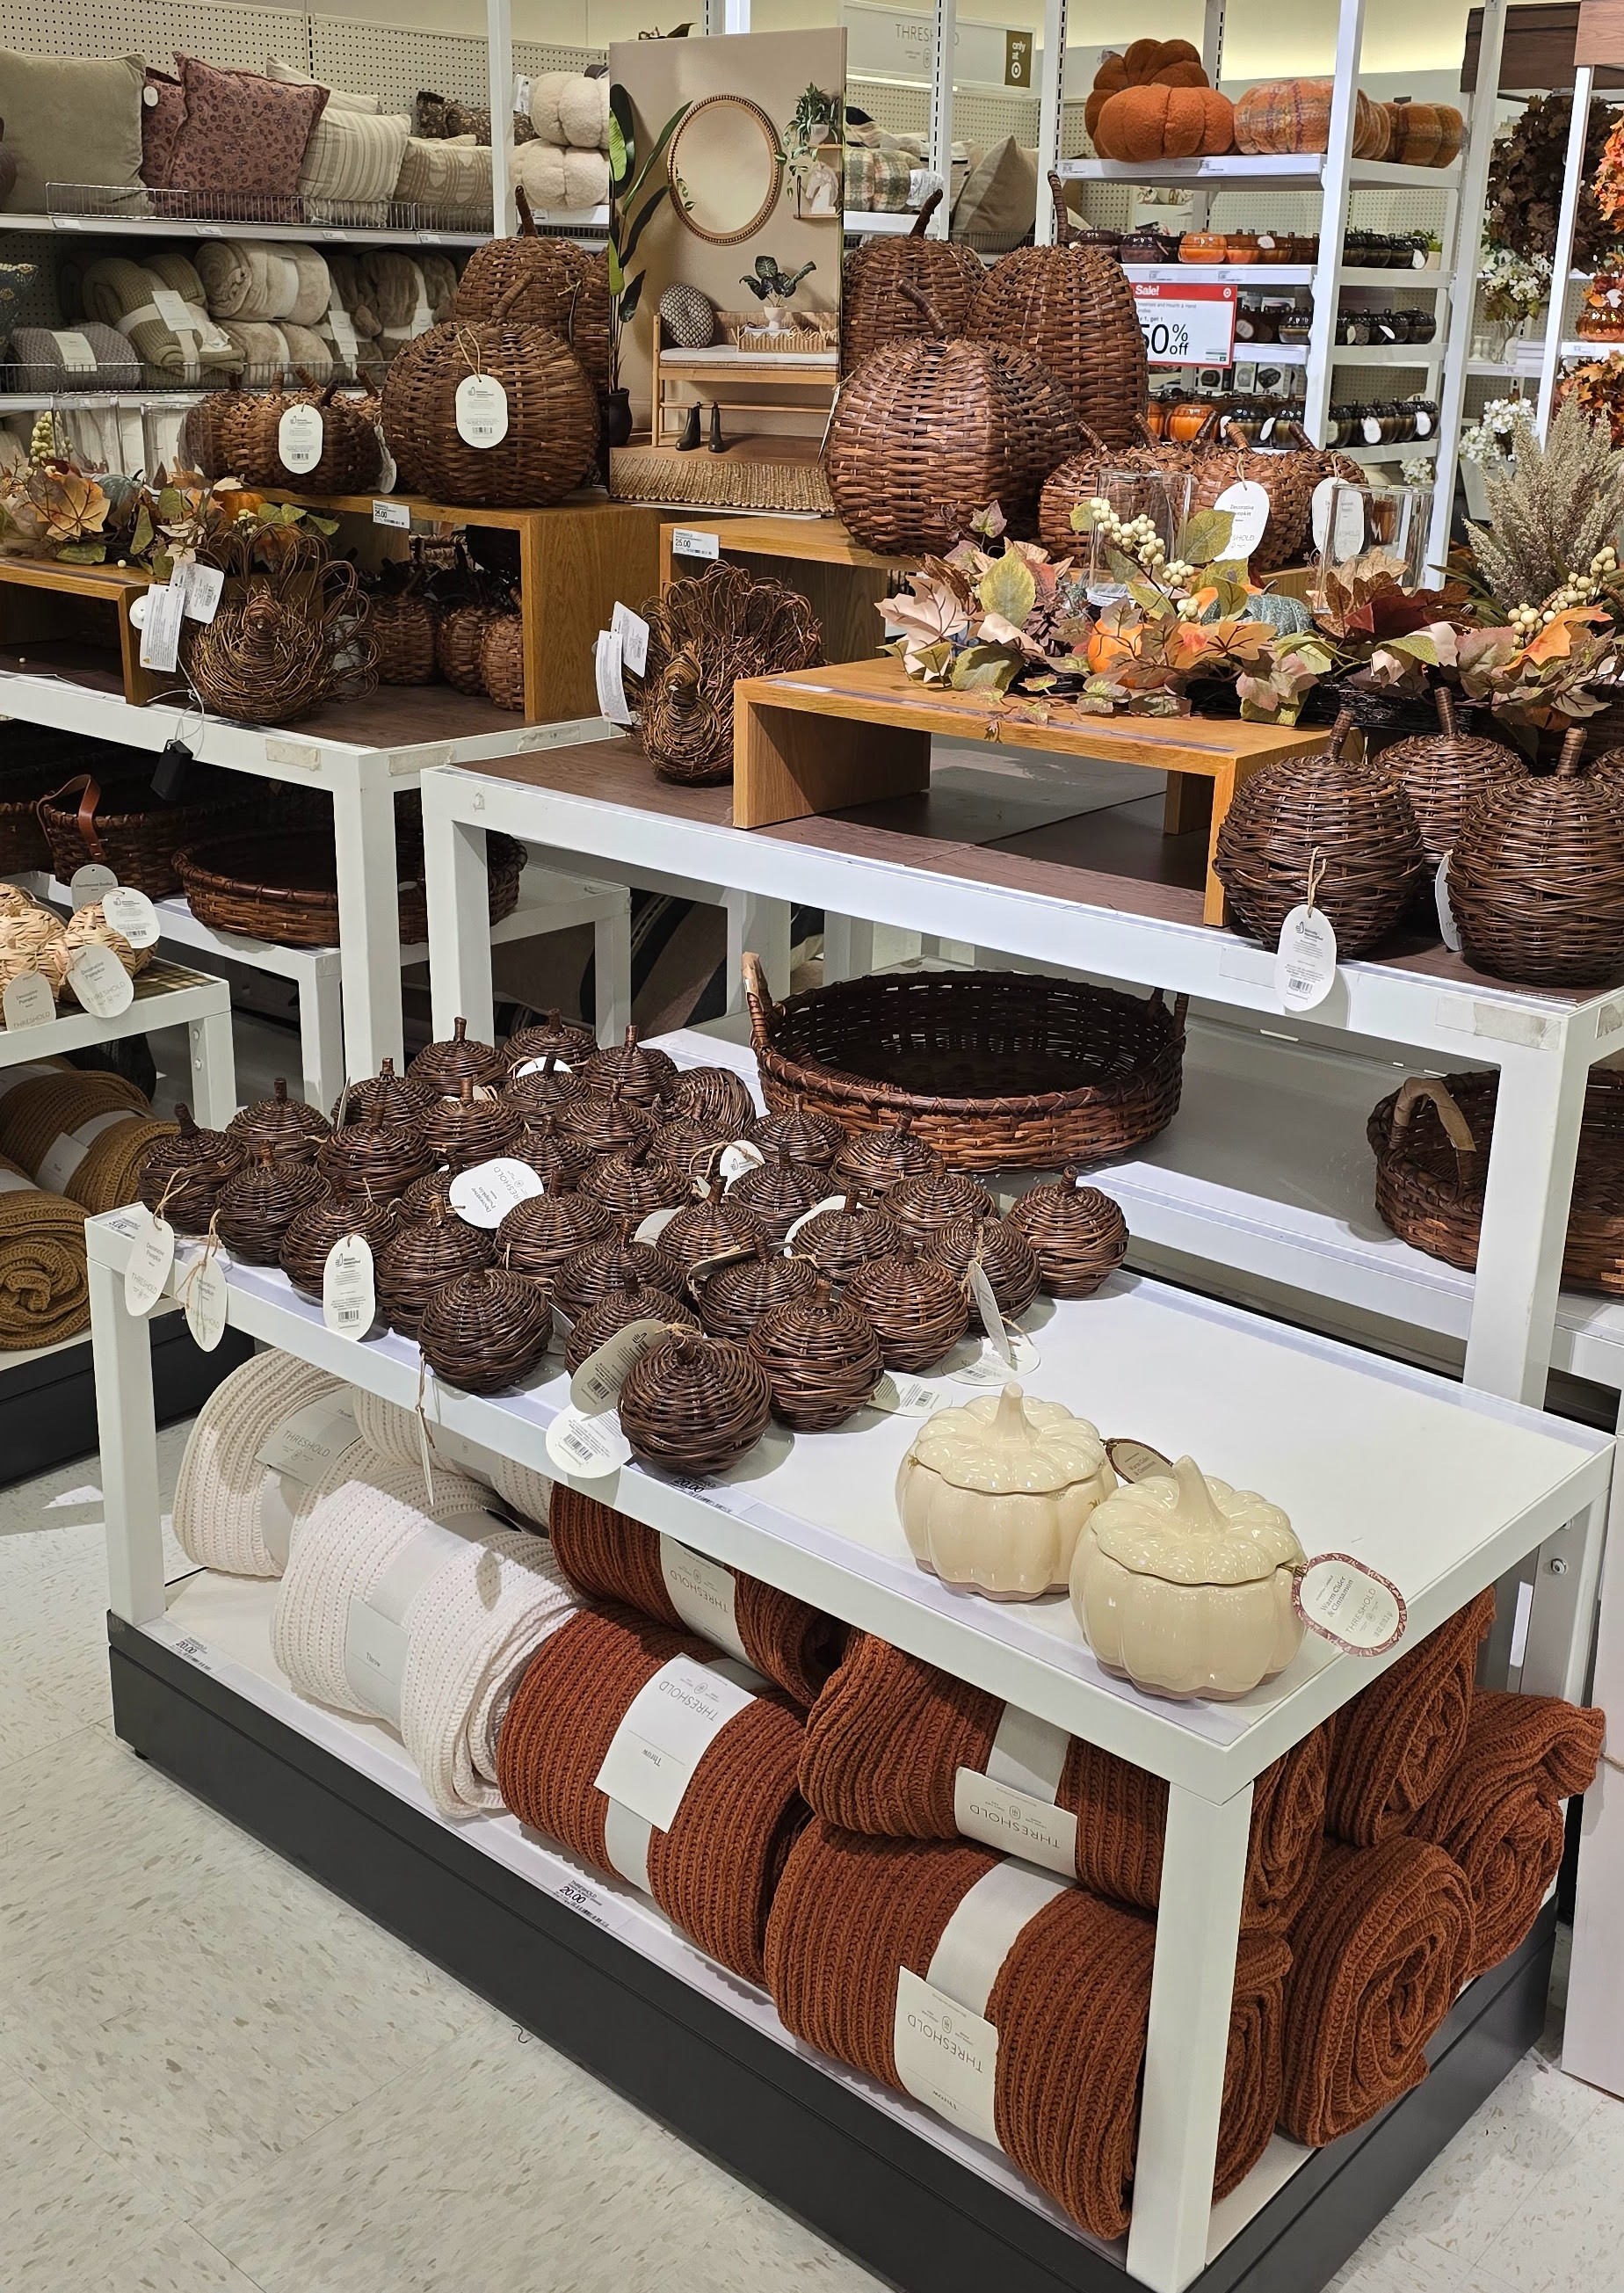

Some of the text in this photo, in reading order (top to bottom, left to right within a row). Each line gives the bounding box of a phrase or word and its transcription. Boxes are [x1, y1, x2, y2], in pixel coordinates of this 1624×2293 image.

[1011, 40, 1026, 53] only
[1011, 51, 1019, 61] at
[1135, 284, 1160, 296] Sale!
[1169, 342, 1190, 356] off
[87, 981, 126, 1004] THRESHOLD
[13, 1011, 51, 1029] THRESHOLD
[493, 1166, 521, 1201] RESHOLD
[131, 1273, 158, 1295] THRESHOLD
[282, 1429, 331, 1457] THRESHOLD
[673, 1477, 705, 1493] 20.00
[670, 1570, 729, 1615] THRESHOLD
[1321, 1576, 1346, 1611] Warm Cider
[1331, 1578, 1354, 1612] Cinnamon
[1345, 1587, 1376, 1634] THRESHOLD
[658, 1680, 719, 1722] THRESHOLD
[642, 1748, 662, 1767] Throw
[969, 1804, 1060, 1849] THRESHOLD
[559, 1885, 587, 1904] 20.00
[907, 2014, 983, 2073] THRESHOLD
